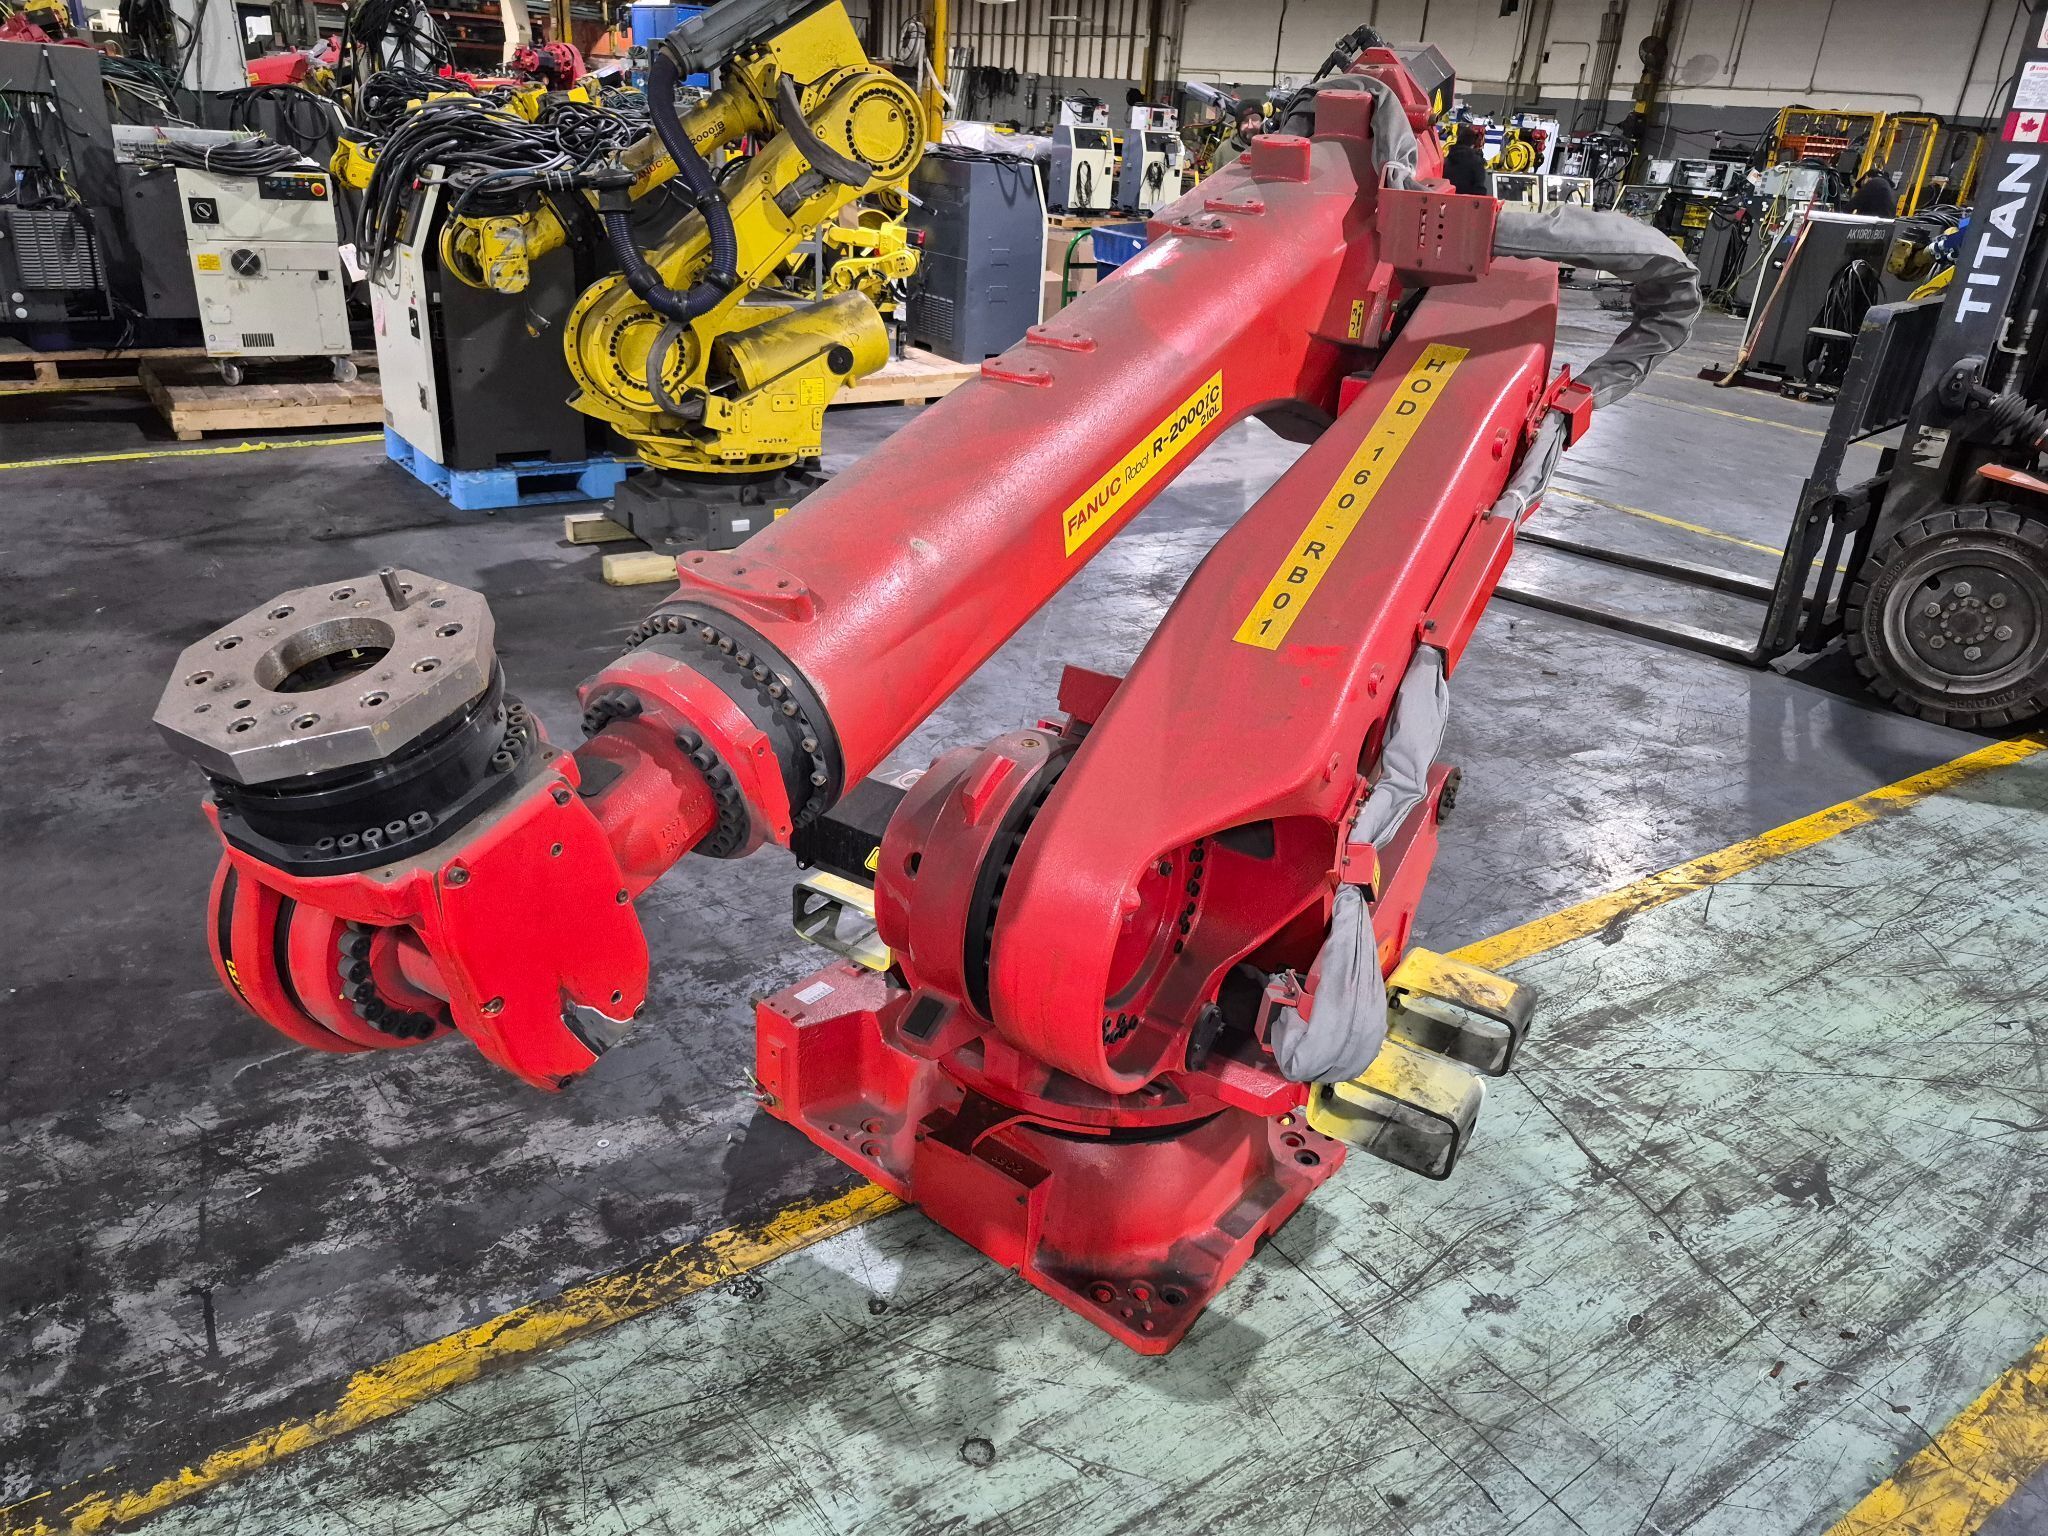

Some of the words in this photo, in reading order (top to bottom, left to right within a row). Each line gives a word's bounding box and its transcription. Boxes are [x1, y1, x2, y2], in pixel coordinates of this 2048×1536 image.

[1954, 153, 2041, 323] TITAN
[1067, 476, 1122, 538] FANUC
[1124, 451, 1150, 485] Robot
[1152, 384, 1220, 459] R-2000iC
[1200, 403, 1220, 427] 210L
